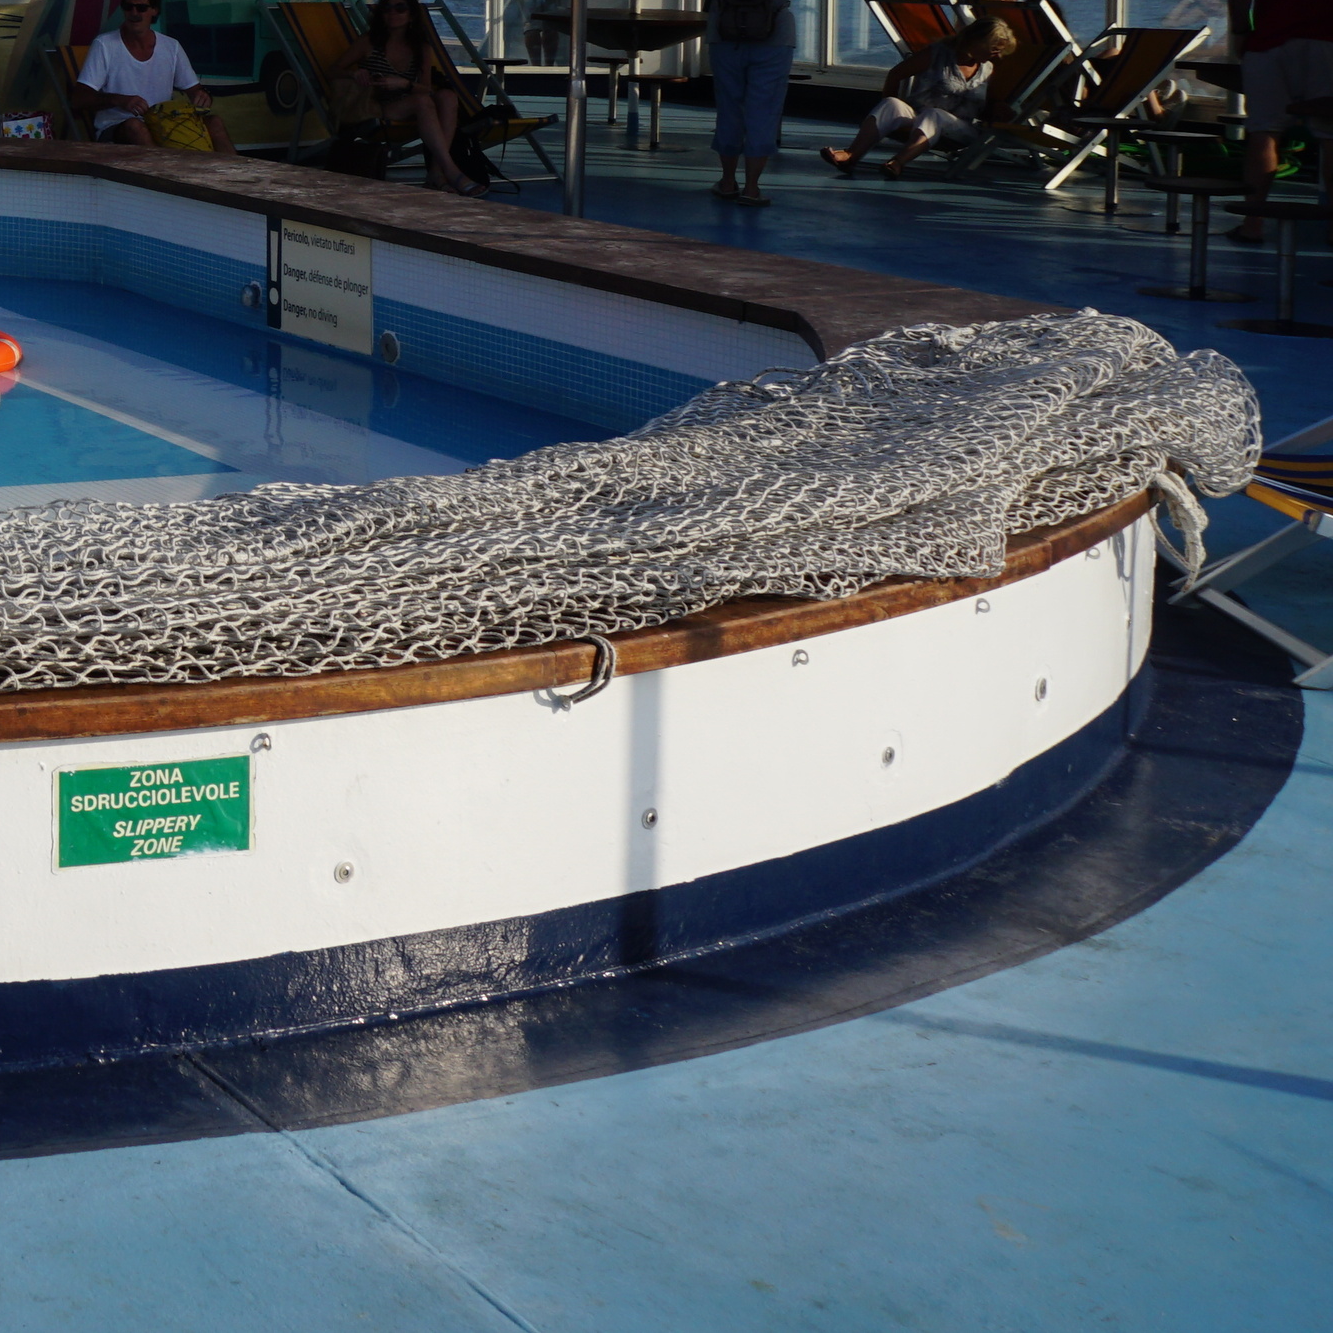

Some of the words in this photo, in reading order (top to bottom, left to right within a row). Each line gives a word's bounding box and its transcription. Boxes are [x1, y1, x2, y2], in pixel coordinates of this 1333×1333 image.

[283, 228, 310, 246] Pericolo,
[310, 234, 332, 250] vietato
[333, 239, 355, 255] tuffarsi
[283, 263, 308, 282] Danger,
[308, 269, 333, 287] défense
[334, 275, 342, 289] de
[343, 278, 368, 297] plonger
[283, 299, 308, 318] Danger,
[308, 308, 317, 319] no
[318, 308, 338, 328] diving
[130, 768, 183, 788] ZONA
[71, 782, 240, 812] SDRUCCIOLEVOLE
[113, 814, 201, 838] SLIPPERY
[130, 836, 183, 856] ZONE
